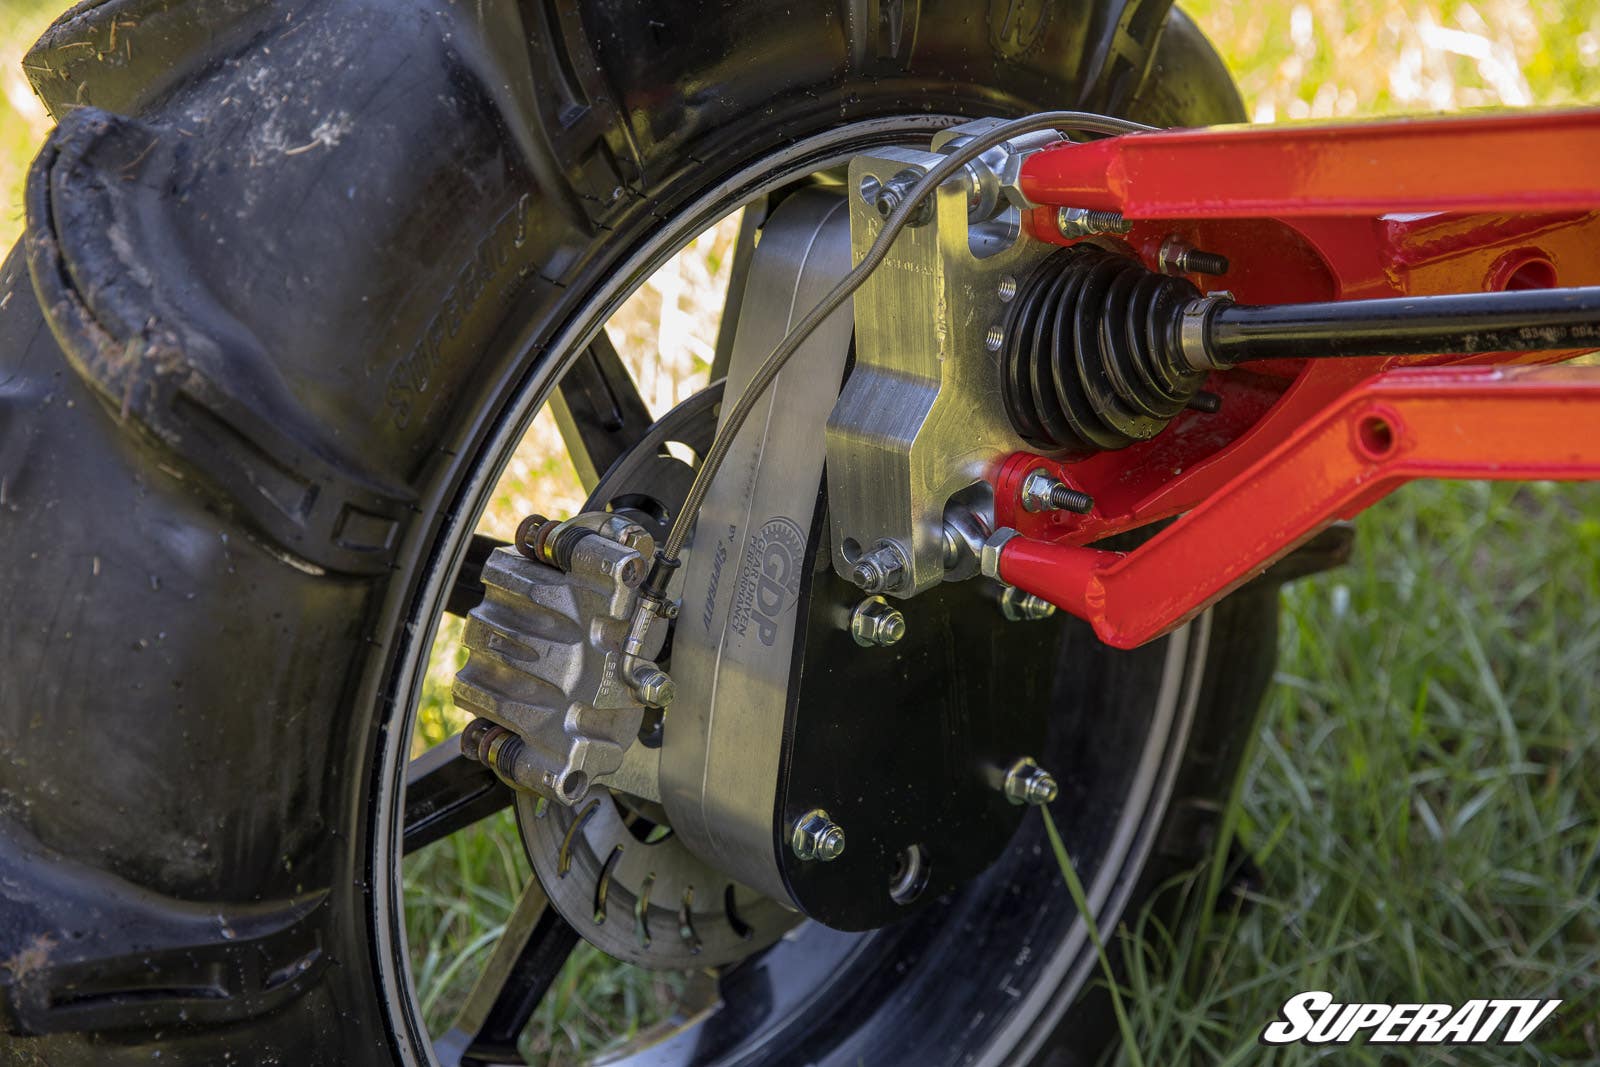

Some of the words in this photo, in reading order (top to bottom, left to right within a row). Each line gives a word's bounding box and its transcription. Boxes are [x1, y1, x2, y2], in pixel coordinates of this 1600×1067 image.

[727, 524, 737, 543] BY
[749, 536, 766, 579] GEAR
[732, 536, 758, 632] PERFORMANCE
[737, 580, 757, 638] DRIVEN
[751, 541, 793, 646] GDP
